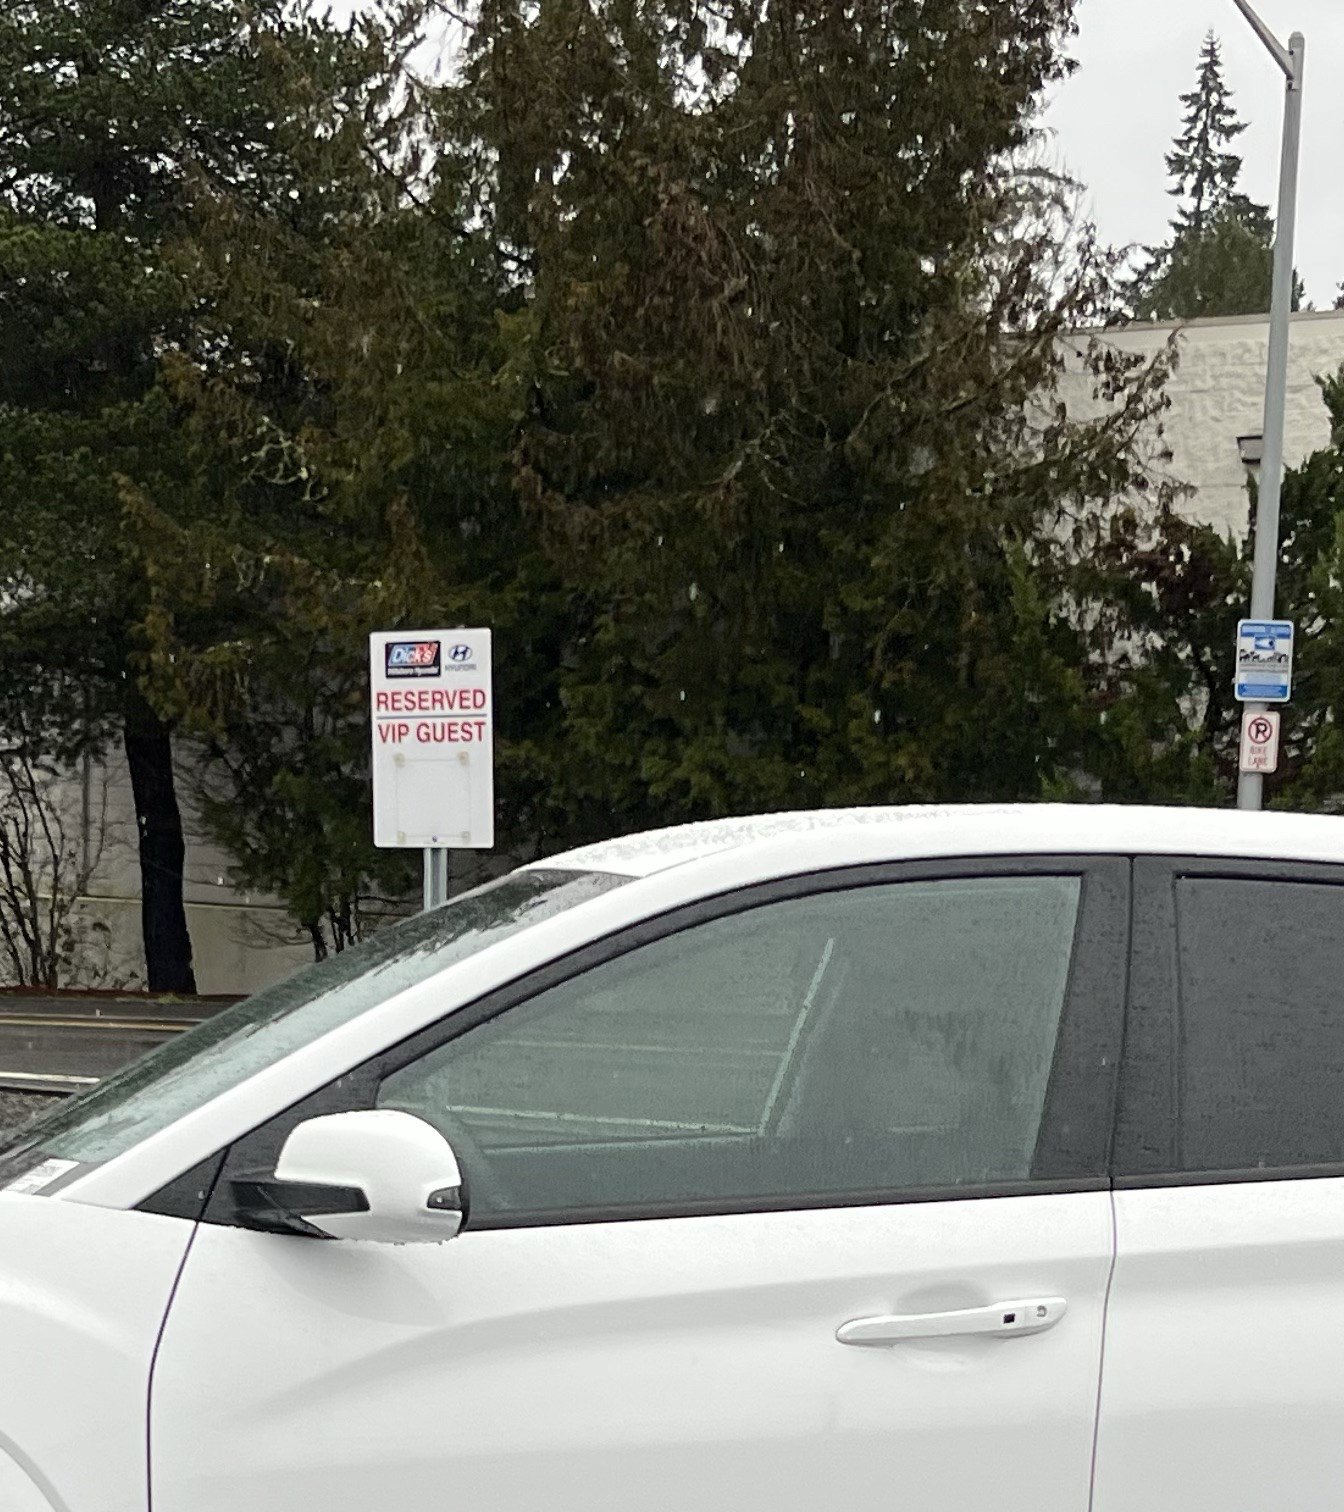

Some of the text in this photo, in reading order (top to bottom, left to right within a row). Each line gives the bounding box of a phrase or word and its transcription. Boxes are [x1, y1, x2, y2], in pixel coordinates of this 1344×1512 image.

[375, 688, 487, 712] RESERVED
[378, 720, 486, 743] VIP GUEST
